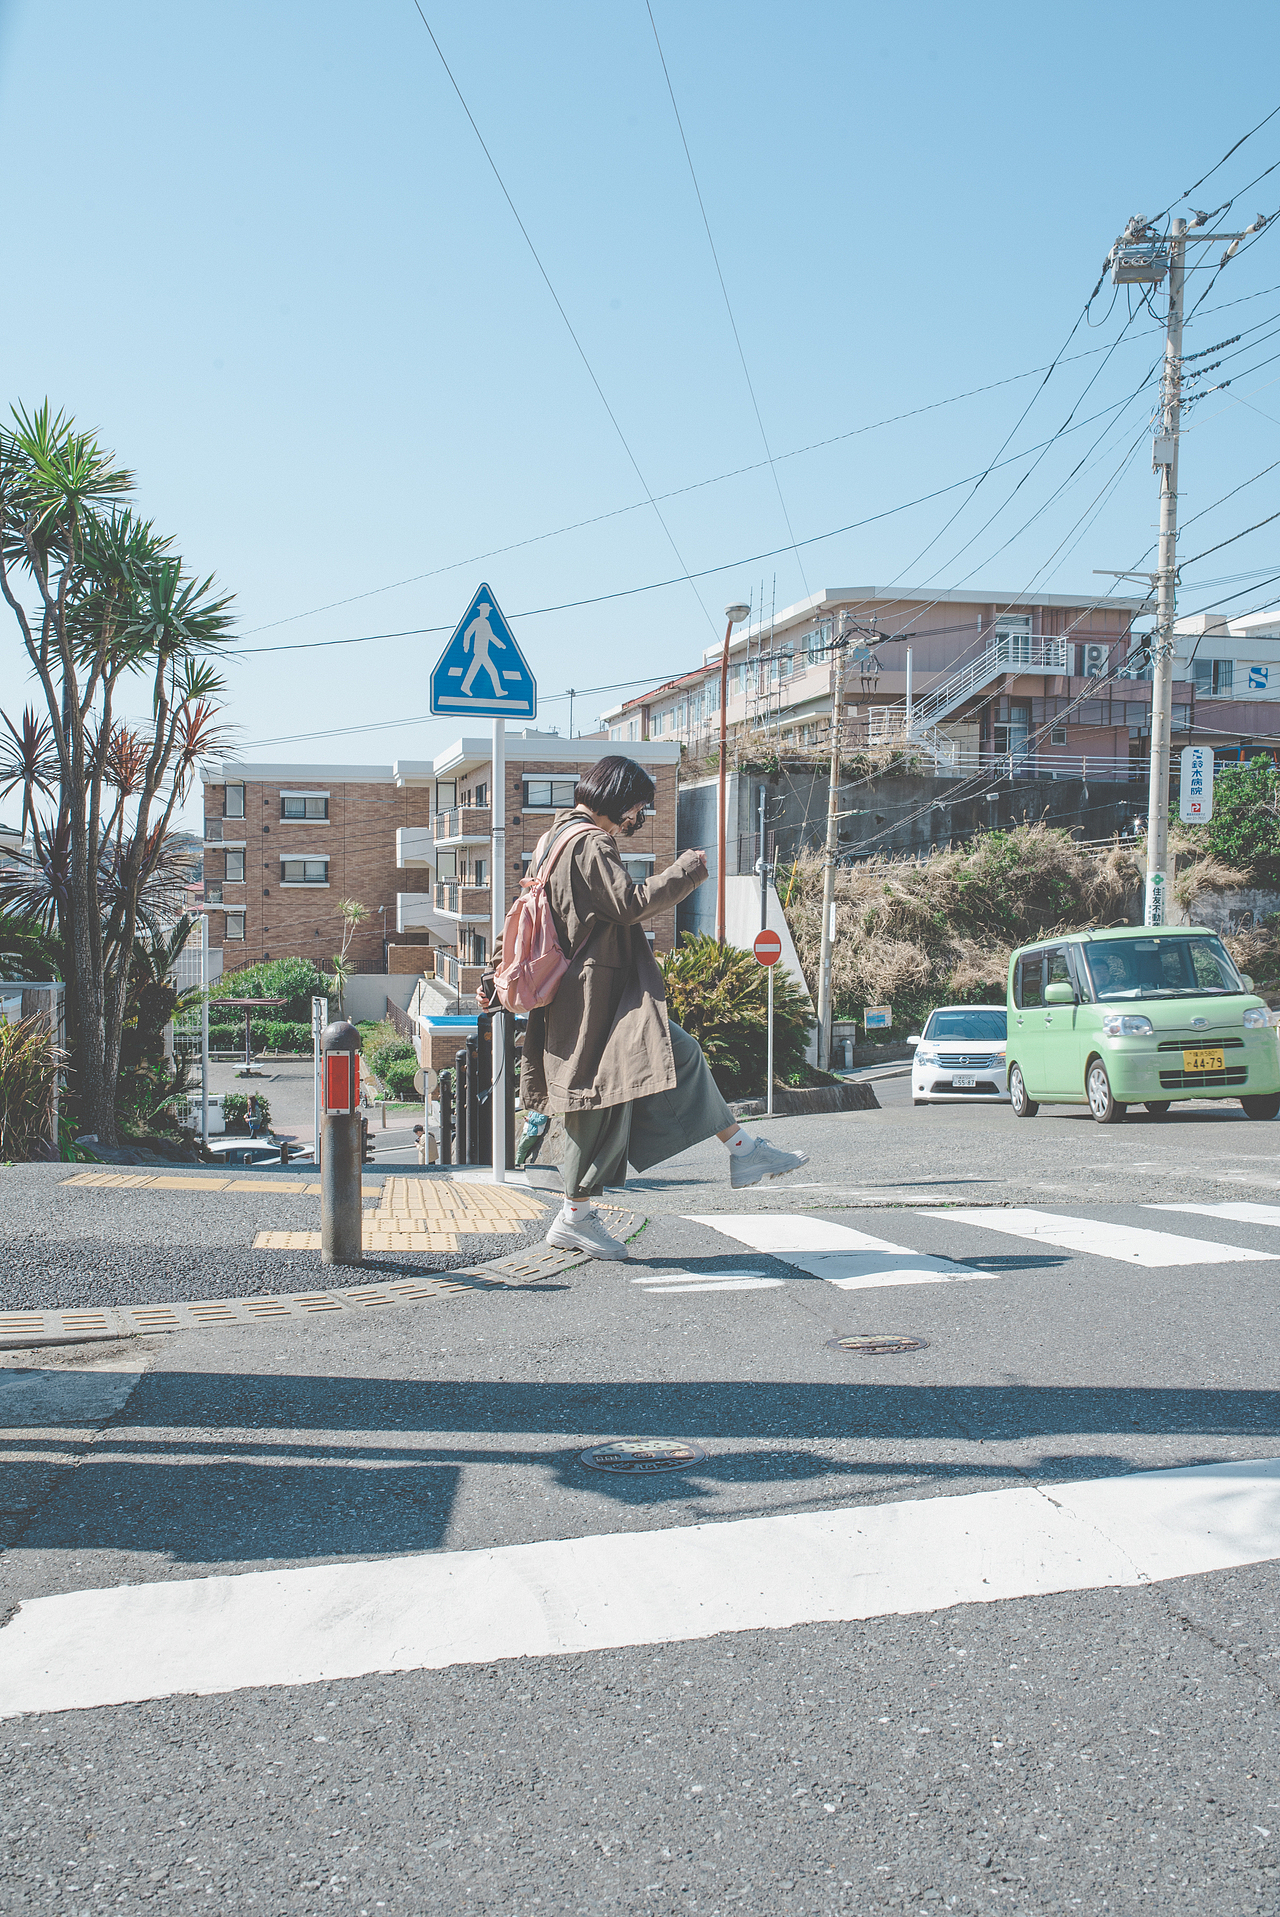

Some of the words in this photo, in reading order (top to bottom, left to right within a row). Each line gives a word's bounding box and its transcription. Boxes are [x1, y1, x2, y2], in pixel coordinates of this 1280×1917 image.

[1191, 760, 1203, 795] 鈴木病院
[1193, 1057, 1222, 1069] 44-79
